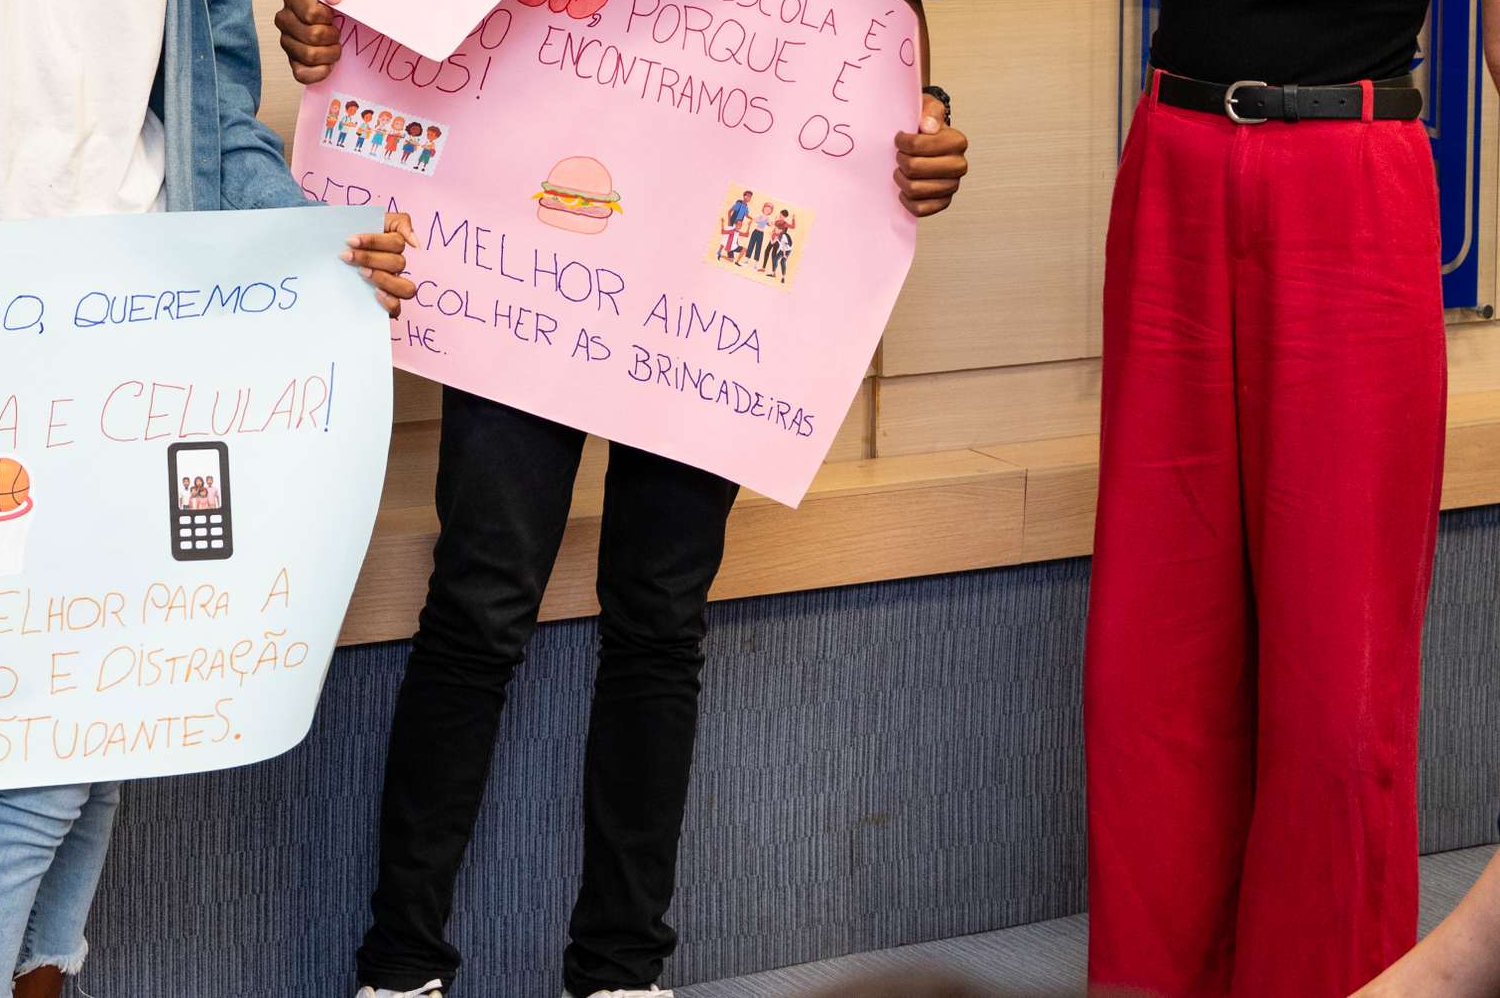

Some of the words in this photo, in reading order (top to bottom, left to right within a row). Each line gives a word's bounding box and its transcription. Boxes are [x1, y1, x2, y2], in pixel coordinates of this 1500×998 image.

[864, 10, 894, 52] É
[537, 24, 775, 135] ENCONTRAMOS
[798, 114, 857, 159] OS
[831, 52, 874, 104] É
[426, 210, 625, 316] MELHOR
[74, 276, 299, 328] QUEREMOS
[571, 327, 611, 362] AS
[46, 398, 75, 449] E
[100, 362, 336, 442] CELULAR!
[141, 582, 230, 625] PARA
[261, 566, 291, 613] A
[50, 650, 80, 697] E
